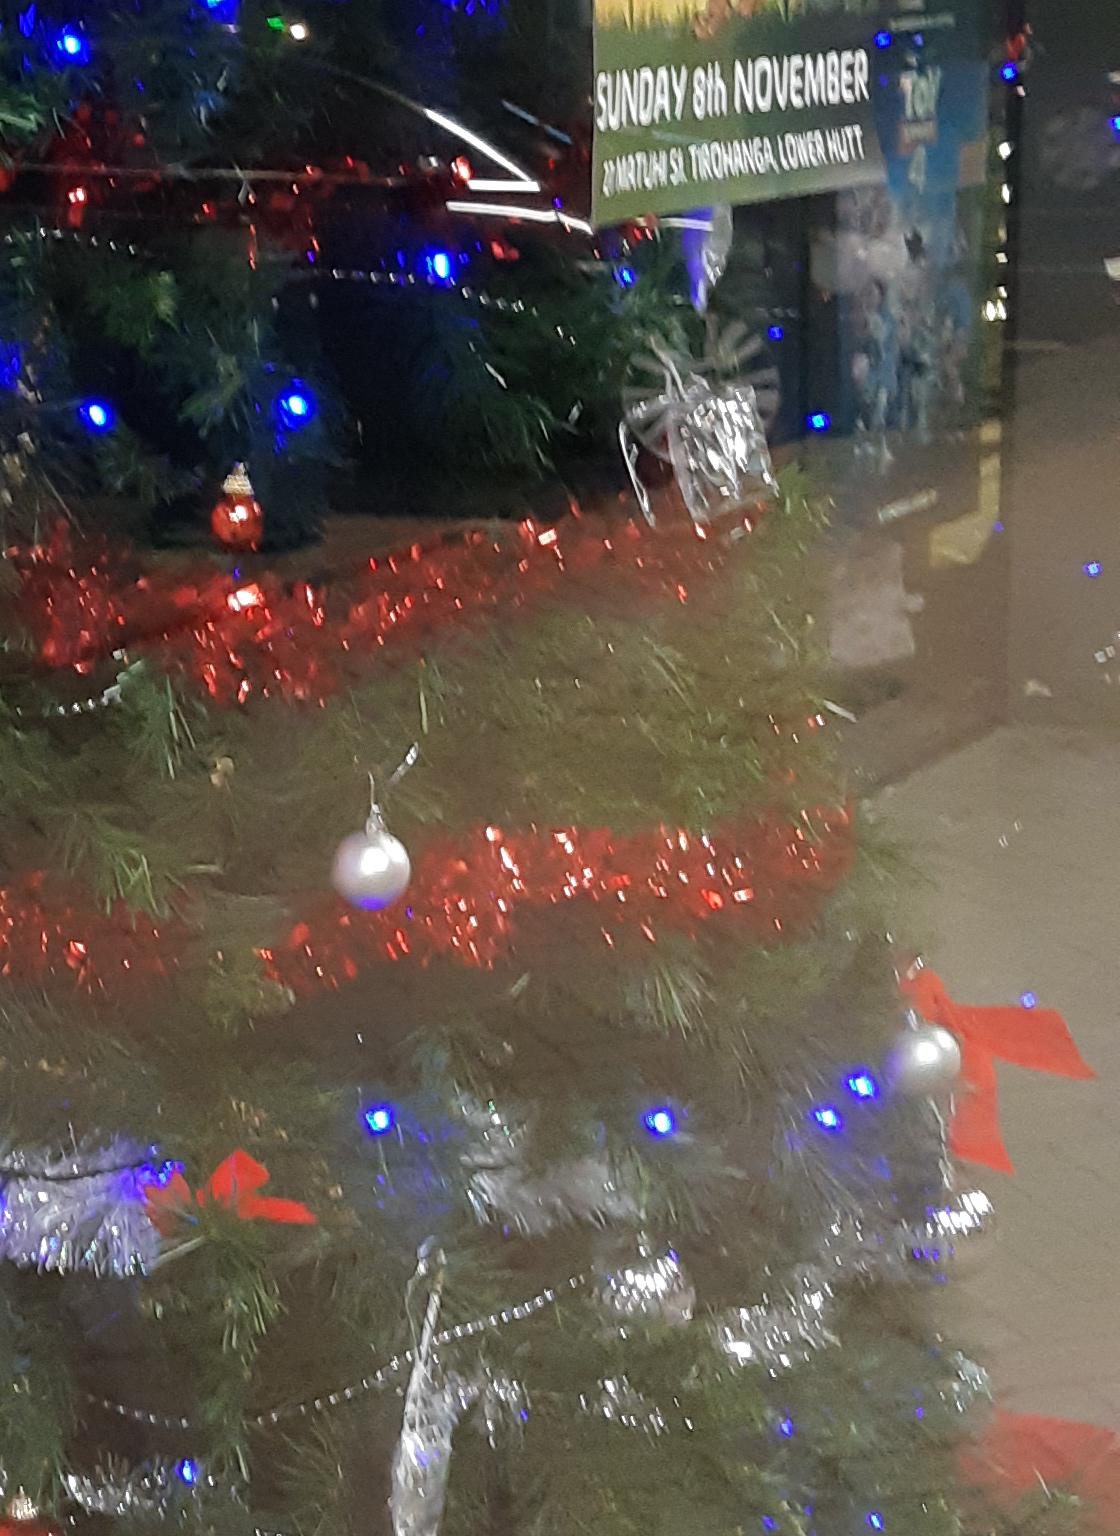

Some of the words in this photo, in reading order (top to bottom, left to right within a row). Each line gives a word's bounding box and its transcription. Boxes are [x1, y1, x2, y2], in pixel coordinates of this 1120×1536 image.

[595, 64, 688, 132] SUNDAY
[692, 60, 727, 120] 8th
[734, 48, 870, 114] NOVEMBER
[778, 128, 830, 171] LOWER
[828, 123, 865, 163] HUTT
